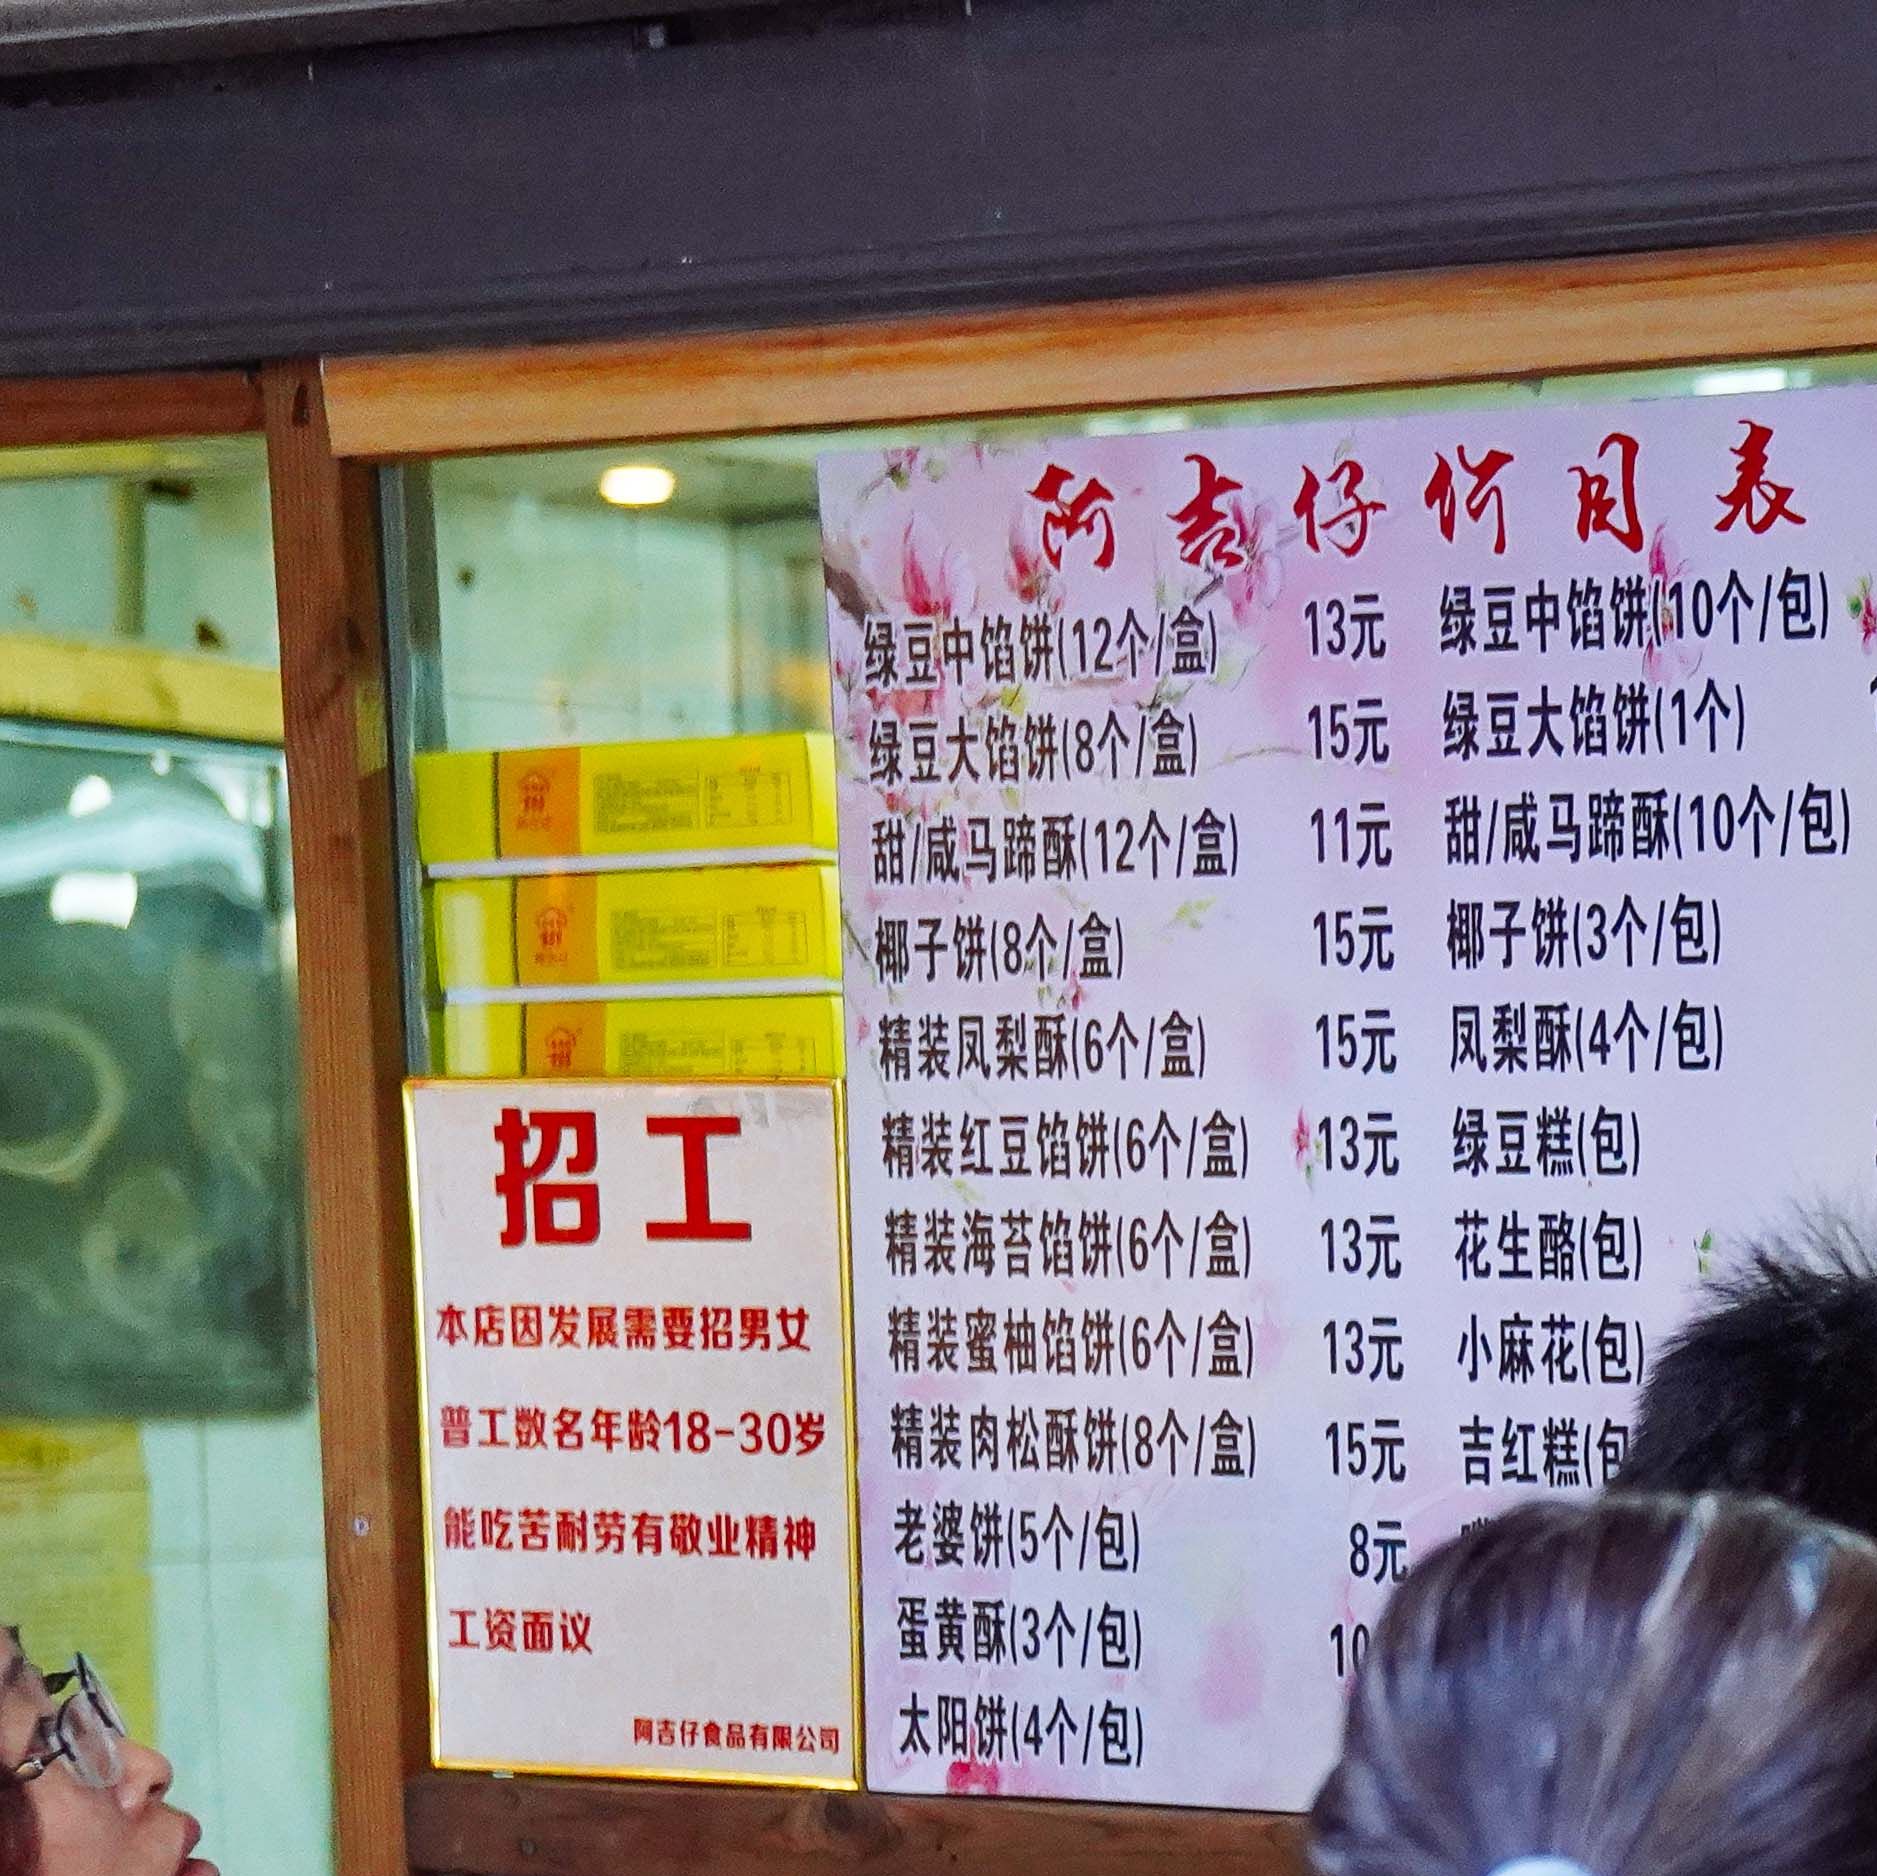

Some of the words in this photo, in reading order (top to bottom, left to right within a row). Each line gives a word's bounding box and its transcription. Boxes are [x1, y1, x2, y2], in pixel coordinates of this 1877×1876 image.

[863, 604, 1218, 689] 绿豆中馅饼(12个/盒)
[1305, 594, 1387, 661] 13元
[1439, 567, 1830, 656] 绿豆中馅饼(10个/包)
[869, 706, 1198, 787] 绿豆大馅饼(8个/盒)
[1307, 698, 1390, 764] 15元
[1443, 677, 1746, 761] 绿豆大馅饼(1个)
[871, 807, 1239, 884] 甜/咸马蹄酥(12个/盒)
[1310, 802, 1393, 869] 11元
[1444, 783, 1851, 866] 甜/咸马蹄酥(10个/包)
[875, 911, 1125, 984] 椰子饼(8个/盒)
[1313, 905, 1395, 973] 15元
[1447, 894, 1722, 970] 椰子饼(3个/包)
[878, 1009, 1206, 1081] 精装凤梨酥(6个/盒)
[1315, 1009, 1398, 1076] 15元
[1449, 1000, 1723, 1073] 凤梨酥(4个/包)
[495, 1108, 752, 1247] 招工
[881, 1109, 1249, 1181] 精装红豆馅饼(6个/盒)
[1317, 1112, 1401, 1180] 13元
[1452, 1105, 1641, 1176] 绿豆糕(包)
[885, 1208, 1252, 1279] 精装海苔馅饼(6个/盒)
[1321, 1215, 1403, 1280] 13元
[1455, 1210, 1643, 1281] 花生酪(包)
[436, 1303, 812, 1352] 本店因发展需要招男女
[887, 1305, 1254, 1379] 精装蜜柚馅饼(6个/盒)
[1322, 1316, 1405, 1382] 13元
[1457, 1312, 1645, 1386] 小麻花(包)
[439, 1406, 826, 1458] 普工数名年龄18-30岁
[890, 1403, 1257, 1479] 精装肉松酥饼(8个/盒)
[1325, 1418, 1407, 1483] 15元
[444, 1505, 817, 1560] 能吃苦耐劳有敬业精神
[894, 1500, 1140, 1574] 老婆饼(5个/包)
[1349, 1520, 1408, 1584] 8元
[448, 1608, 593, 1655] 工资面议
[897, 1596, 1142, 1671] 蛋黄酥(3个/包)
[634, 1717, 842, 1755] 阿吉仔食品有限公司
[900, 1692, 1145, 1768] 太阳饼(4个/包)
